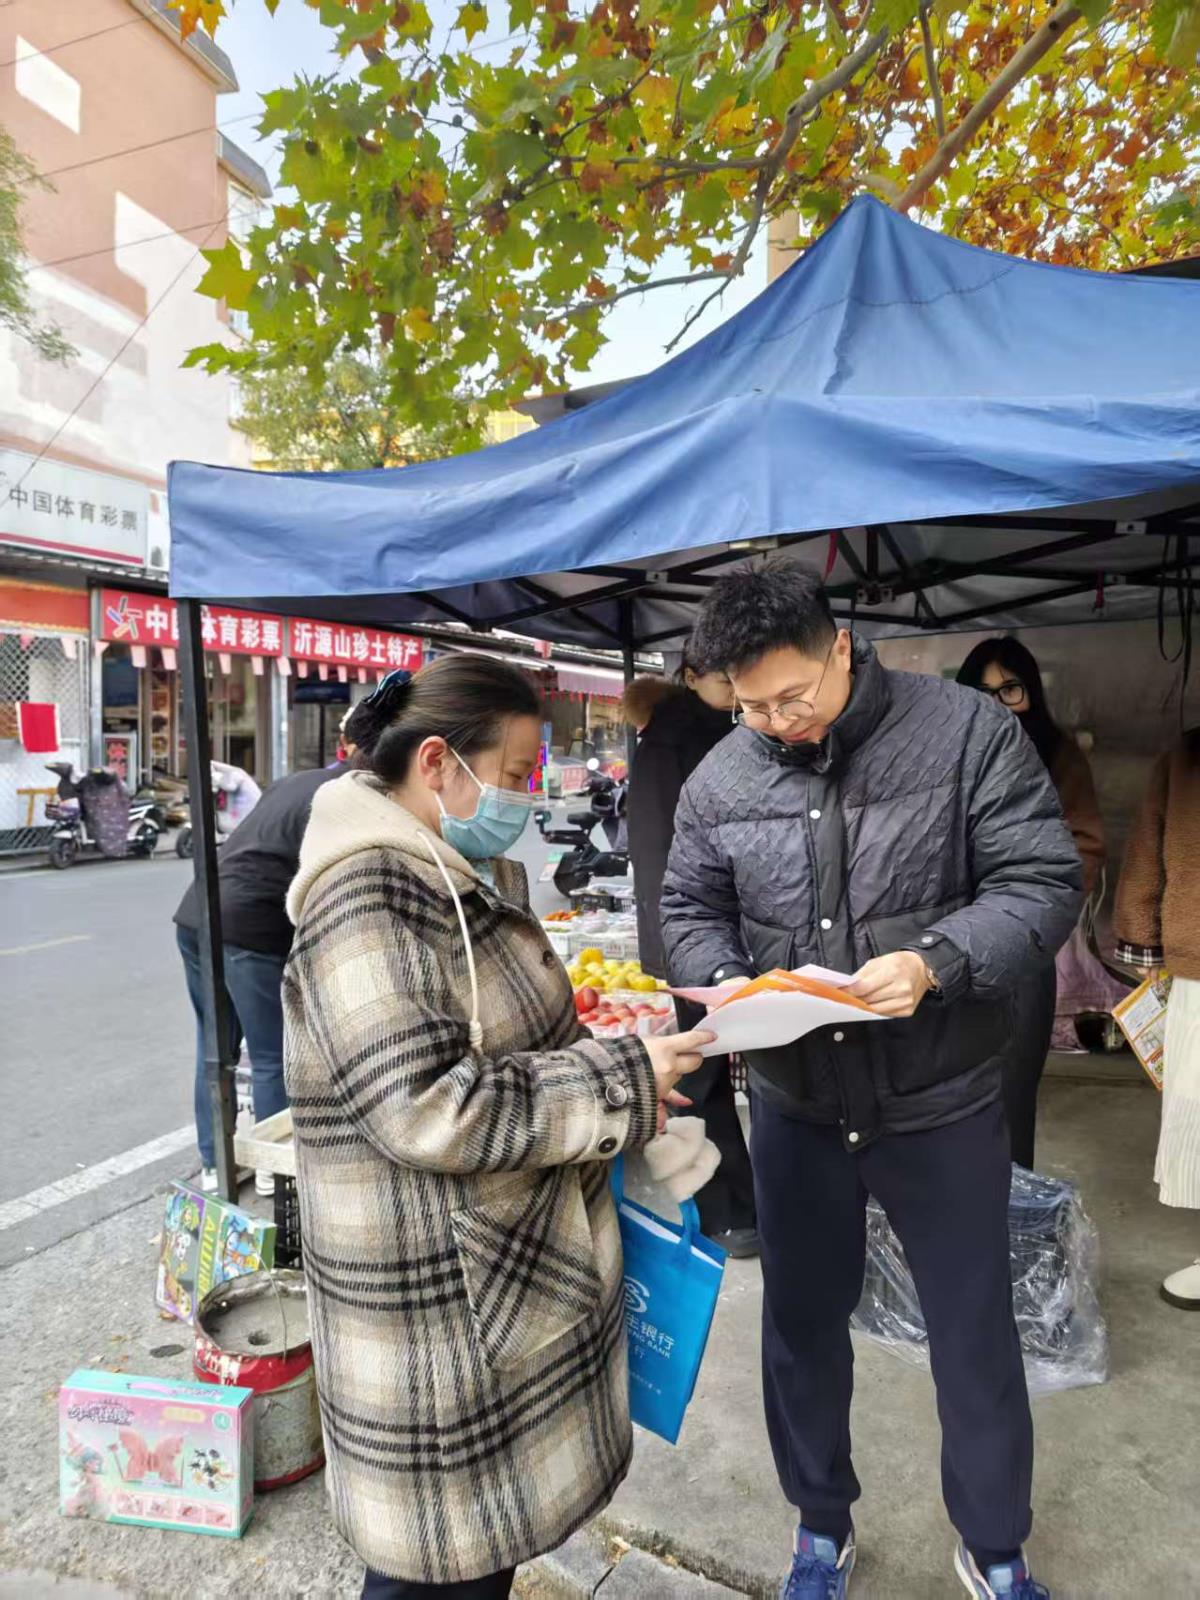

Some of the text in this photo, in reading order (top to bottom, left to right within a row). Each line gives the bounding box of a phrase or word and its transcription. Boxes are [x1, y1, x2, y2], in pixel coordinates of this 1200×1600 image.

[9, 484, 138, 531] 中国体育彩票
[293, 622, 419, 666] 沂源山珍土特产
